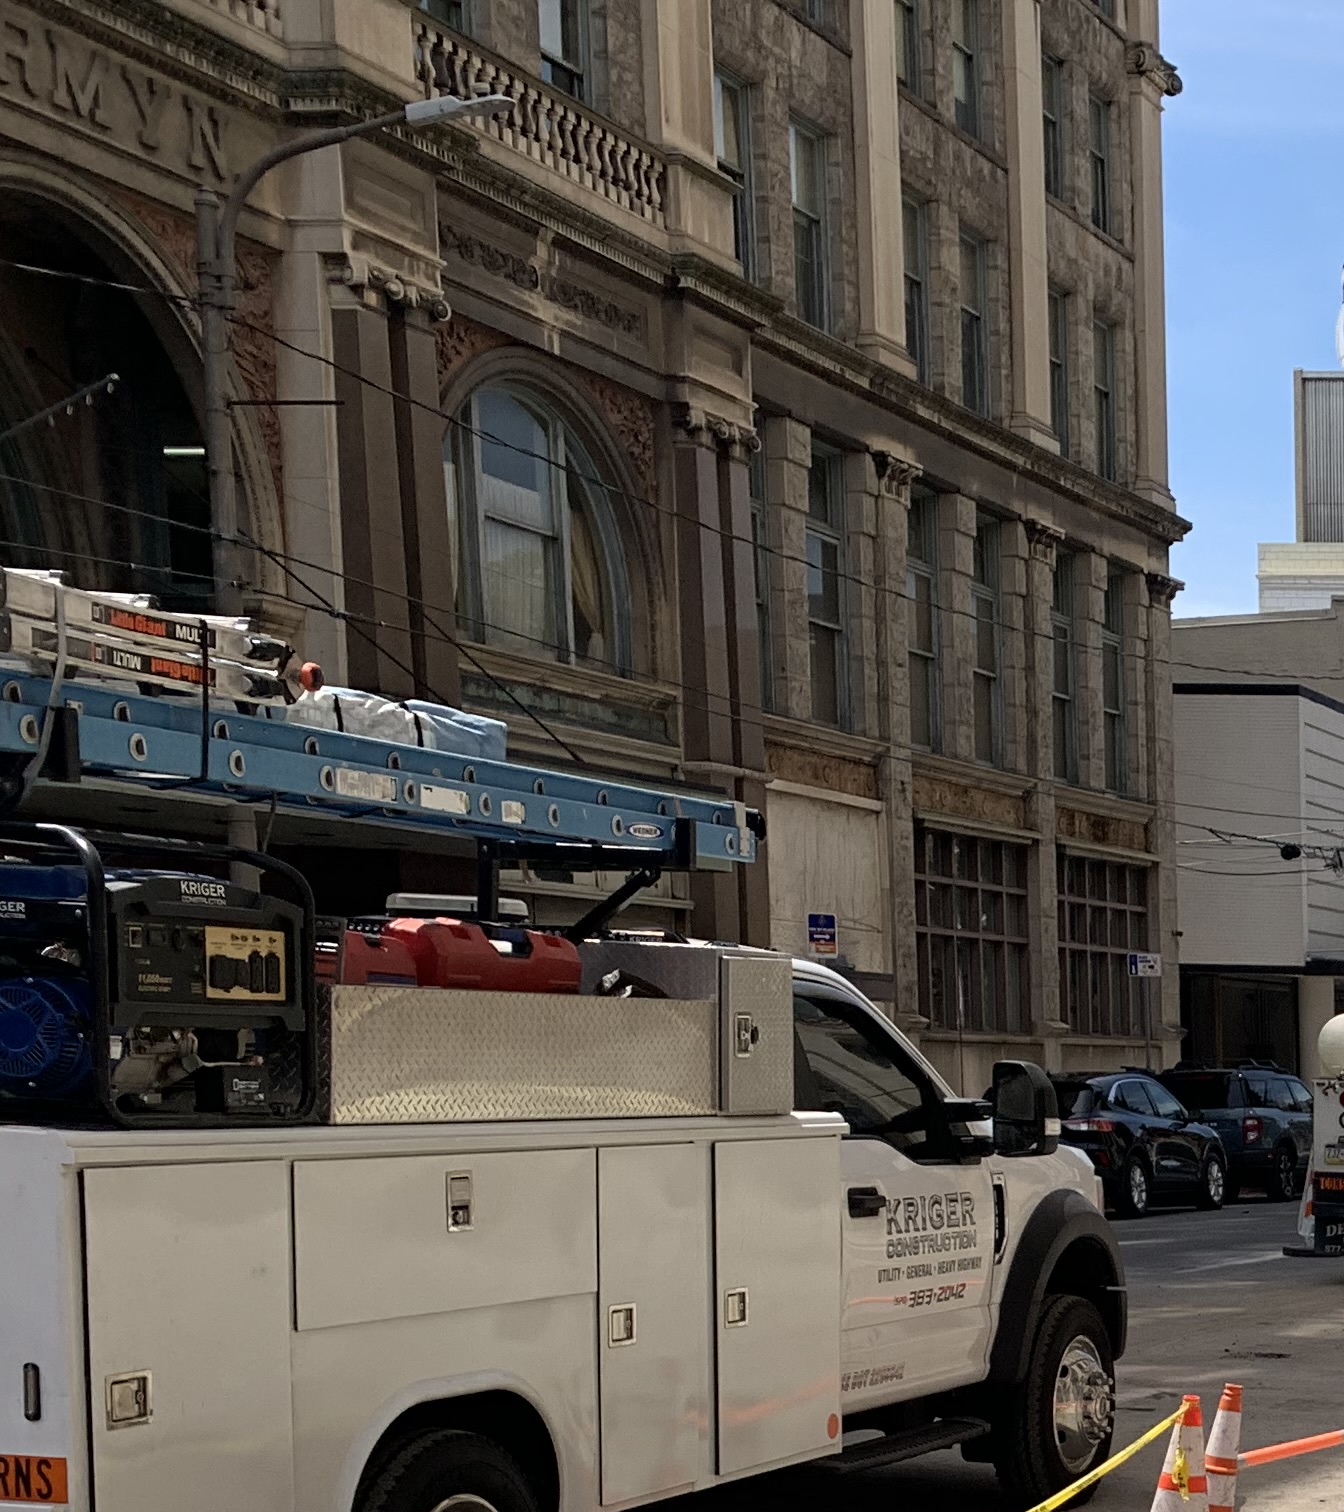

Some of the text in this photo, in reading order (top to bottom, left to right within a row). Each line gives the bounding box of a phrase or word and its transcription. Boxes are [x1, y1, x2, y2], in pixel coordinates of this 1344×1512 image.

[134, 614, 167, 637] Giant
[180, 880, 226, 898] KRIGER
[885, 1191, 977, 1236] KRIGER
[886, 1229, 977, 1260] CONSTRUCTION
[878, 1256, 982, 1284] UTILITY GENERAL HEAVY HIGHWAY
